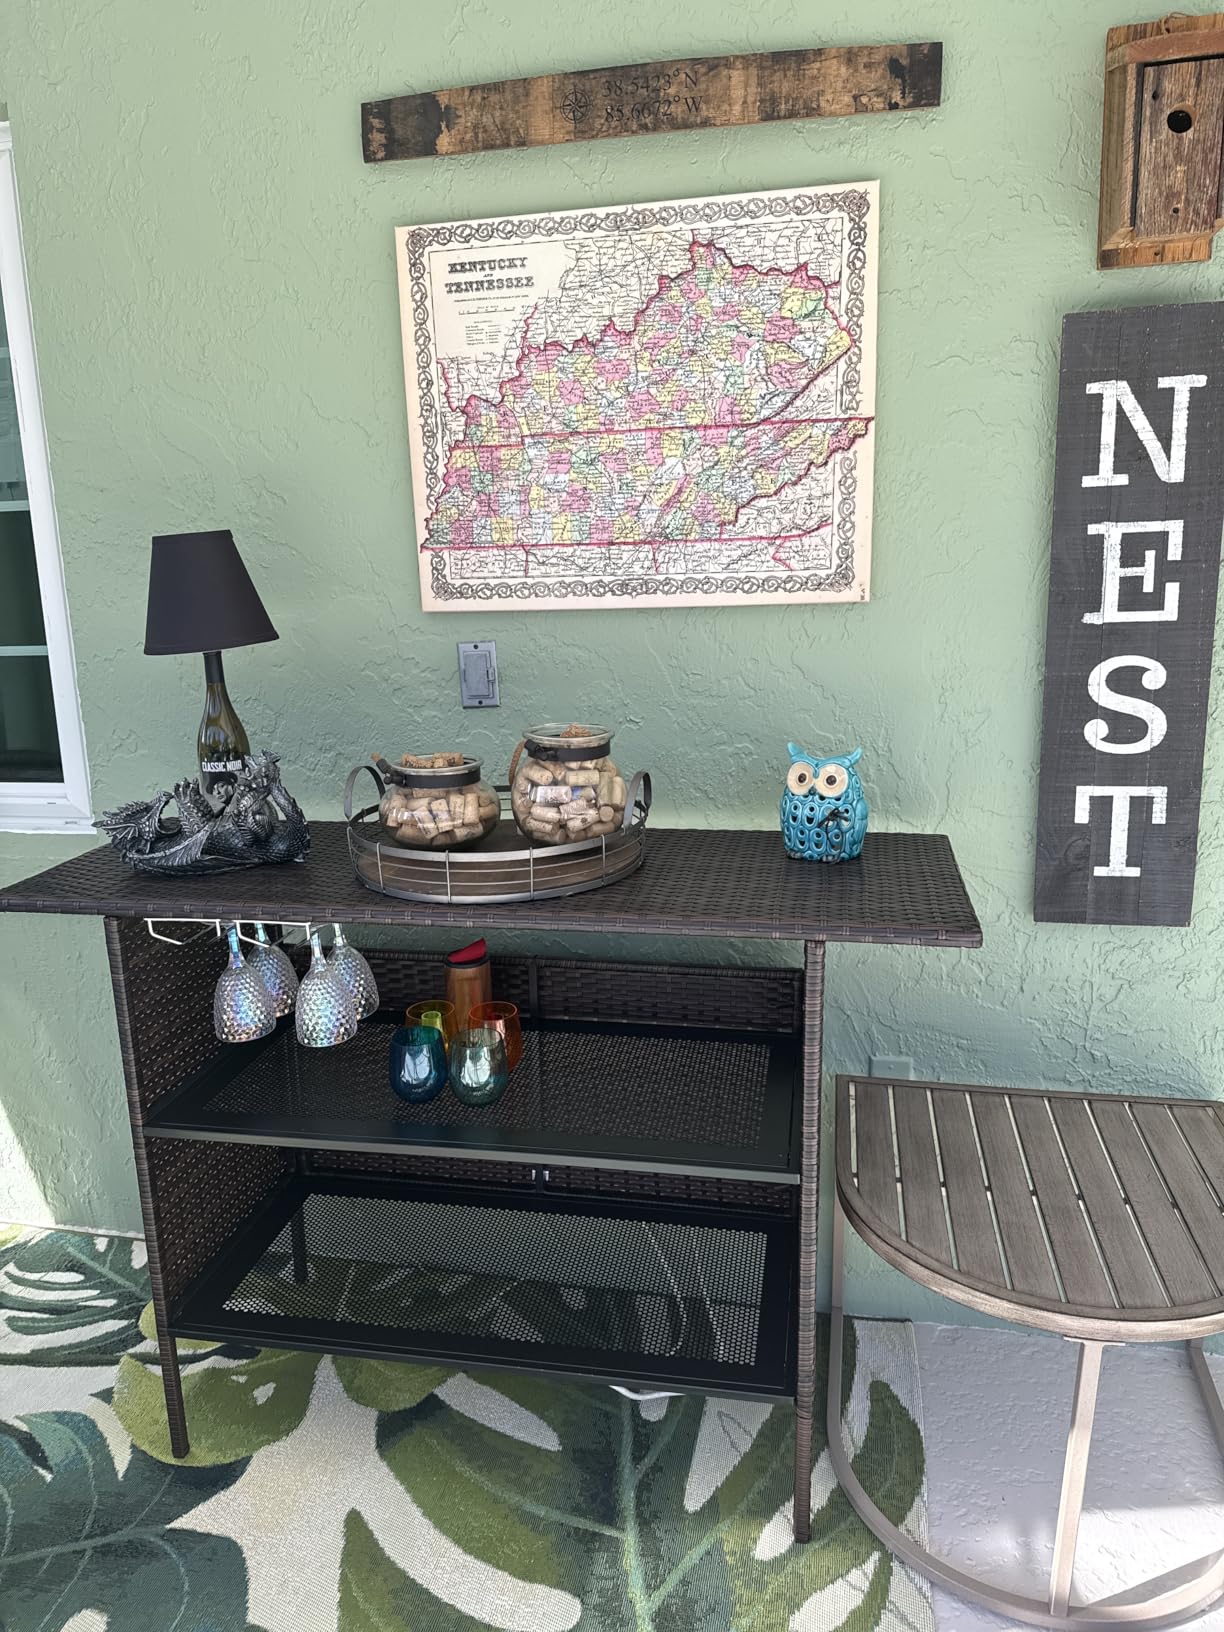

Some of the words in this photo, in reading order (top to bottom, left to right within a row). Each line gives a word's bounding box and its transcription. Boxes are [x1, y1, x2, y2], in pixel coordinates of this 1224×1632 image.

[448, 257, 528, 274] KENTUCKY
[445, 276, 534, 294] TENNESSEE
[1074, 374, 1207, 878] NEST
[202, 761, 226, 772] CLASSIC
[226, 759, 243, 772] NOIR
